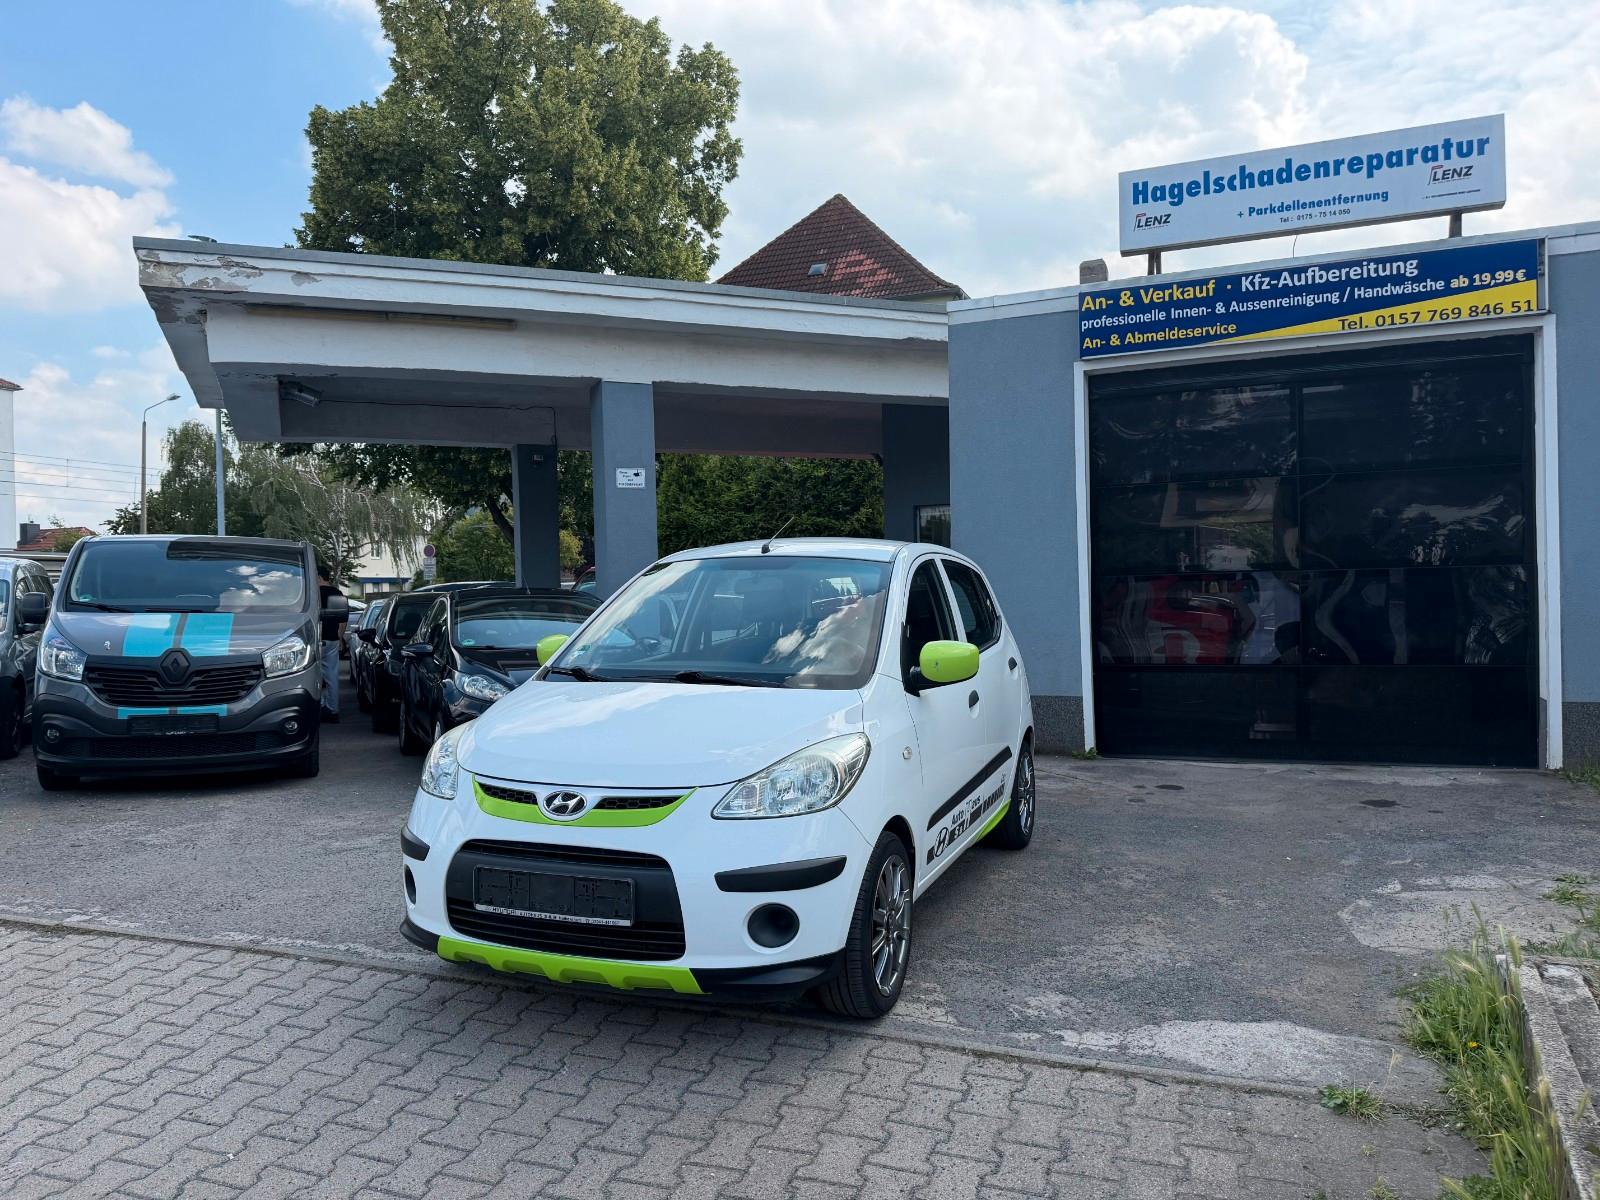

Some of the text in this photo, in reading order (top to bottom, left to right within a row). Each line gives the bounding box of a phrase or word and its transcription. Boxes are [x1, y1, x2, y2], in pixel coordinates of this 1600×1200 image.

[1132, 136, 1490, 207] Hagelschadenreparatur
[1432, 165, 1474, 182] LENZ
[1248, 190, 1390, 217] Parkdellenentfernung
[1136, 213, 1172, 229] LENZ
[1081, 295, 1114, 312] An-
[1119, 290, 1135, 307] &
[1139, 279, 1217, 304] Verkauf
[1241, 258, 1419, 292] Kfz-Aufbereitung
[1081, 310, 1166, 332] professionelle
[1170, 304, 1212, 319] Innen-
[1215, 302, 1226, 314] &
[1229, 290, 1340, 313] Aussenreinigung
[1354, 278, 1445, 300] Handwäsche
[1450, 274, 1469, 288] ab
[1338, 299, 1535, 332] Tel. 0157 769 846 51
[1082, 322, 1237, 350] An- & Abmeldeservice
